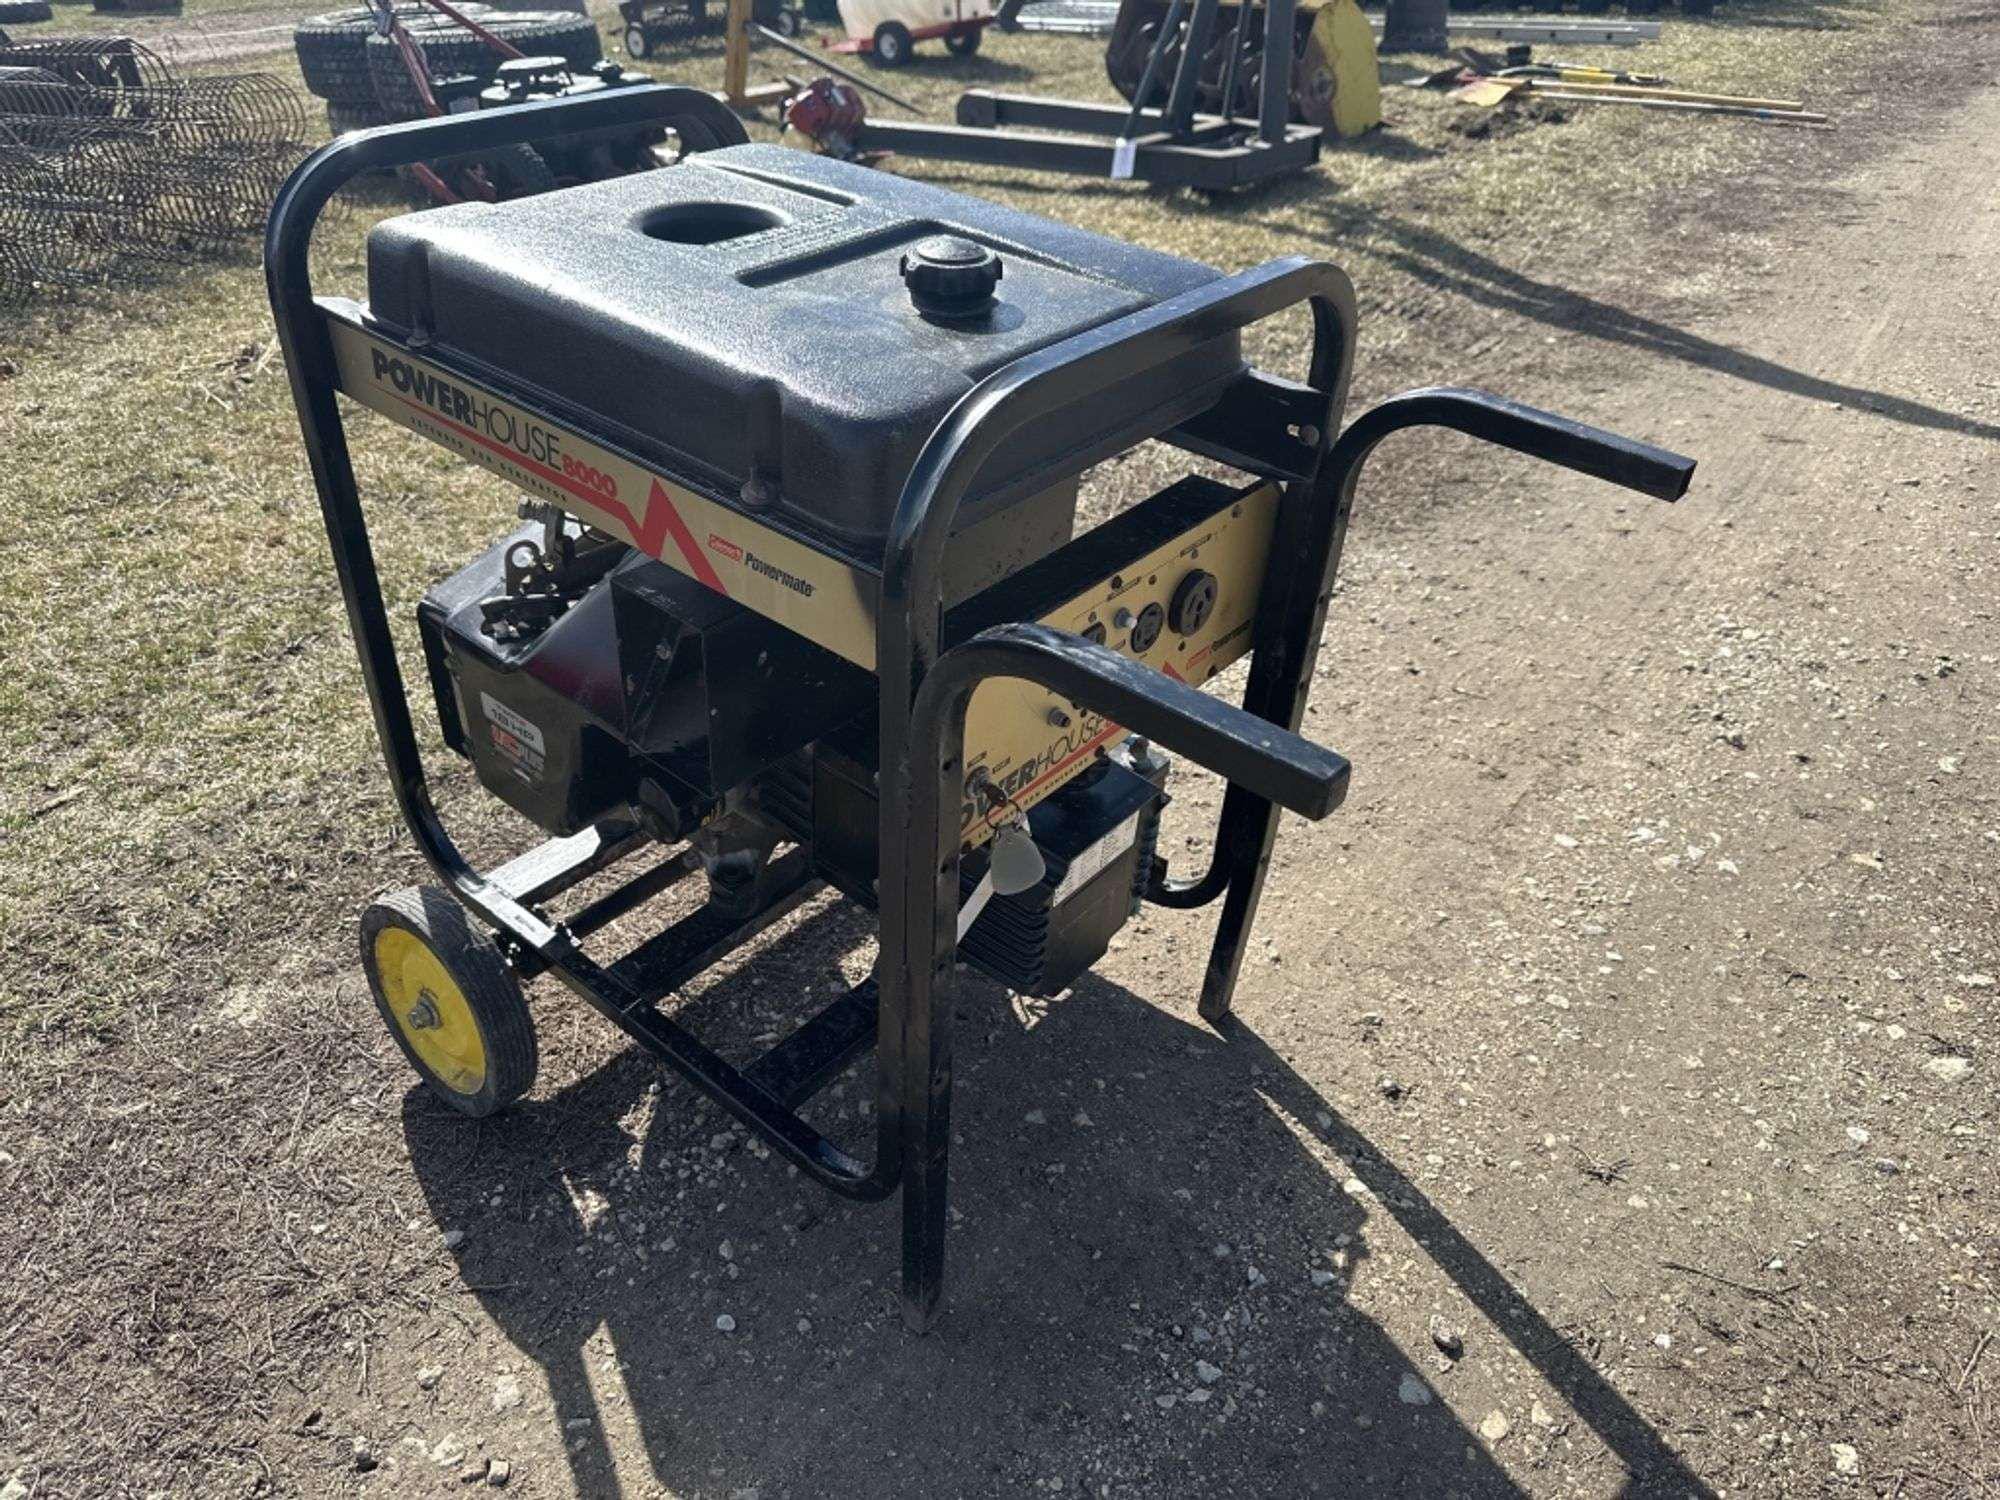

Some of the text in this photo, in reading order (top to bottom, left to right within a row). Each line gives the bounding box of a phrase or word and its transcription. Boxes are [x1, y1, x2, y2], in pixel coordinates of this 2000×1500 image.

[371, 348, 562, 472] POWERHOUSE
[562, 453, 618, 498] 8000
[744, 552, 813, 597] Powermate
